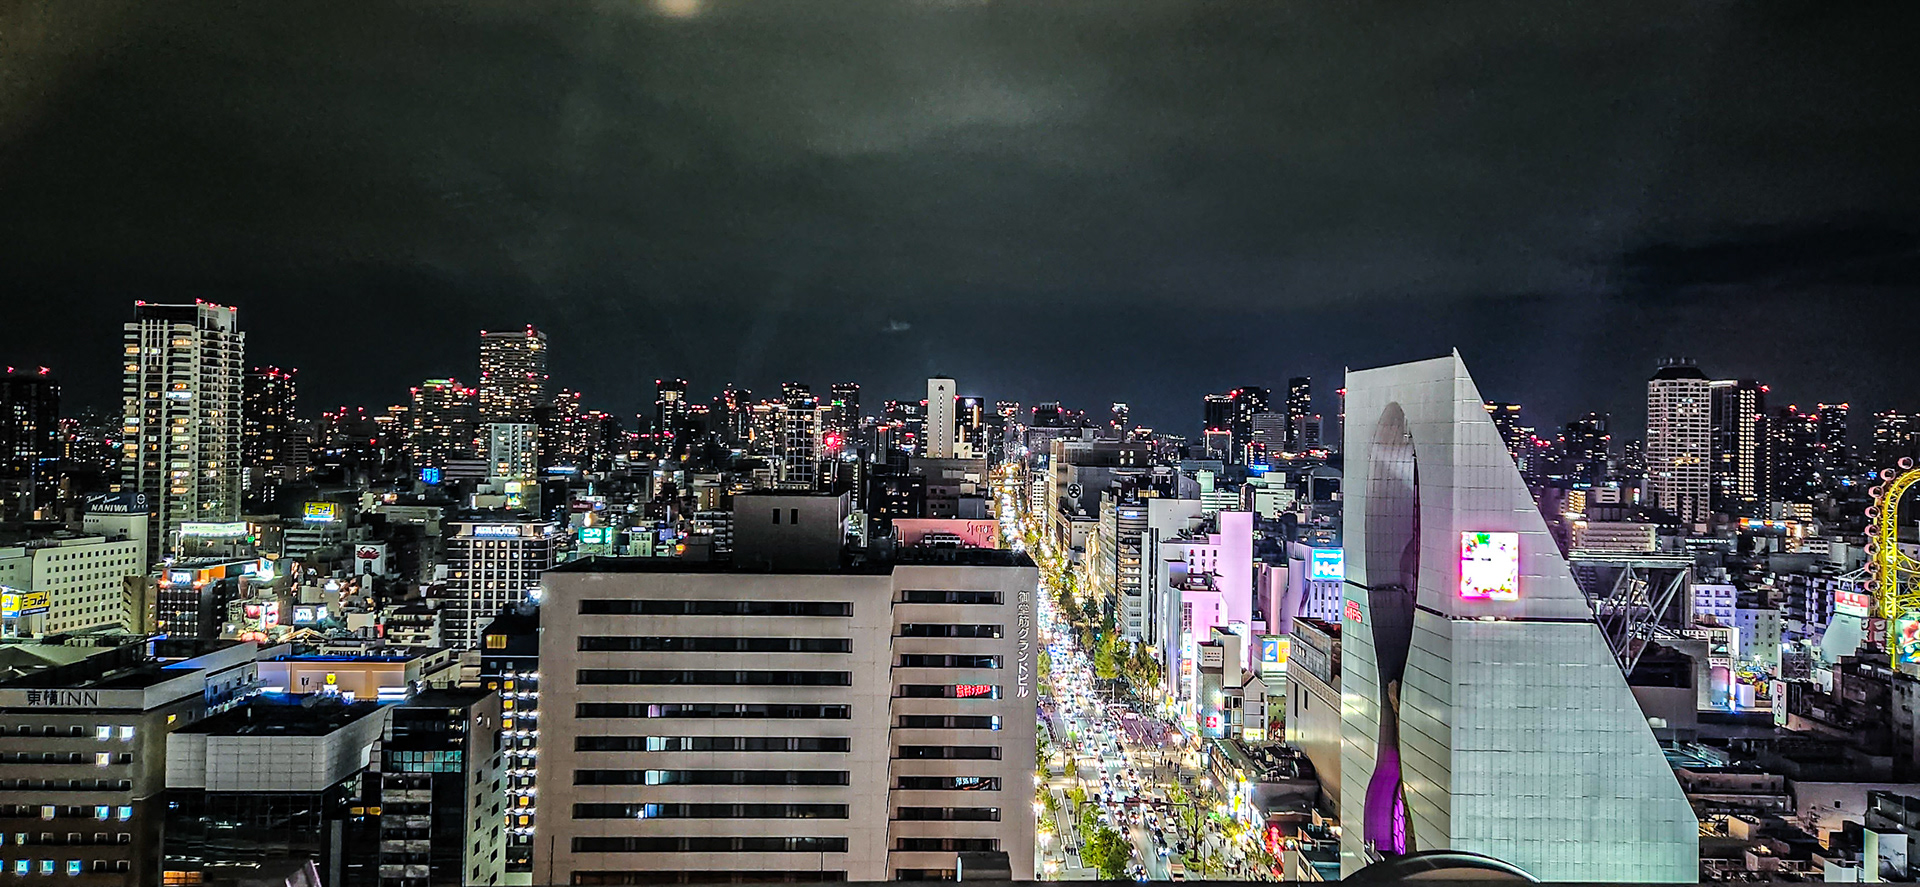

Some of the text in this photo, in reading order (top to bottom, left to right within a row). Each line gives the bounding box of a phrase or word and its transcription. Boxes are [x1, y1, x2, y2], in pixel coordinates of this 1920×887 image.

[91, 504, 128, 512] NANIWA
[492, 525, 518, 534] HOTEL
[1344, 606, 1363, 624] HIPS
[1017, 592, 1030, 698] 御堂筋グランドビル
[27, 690, 98, 706] 東横INN
